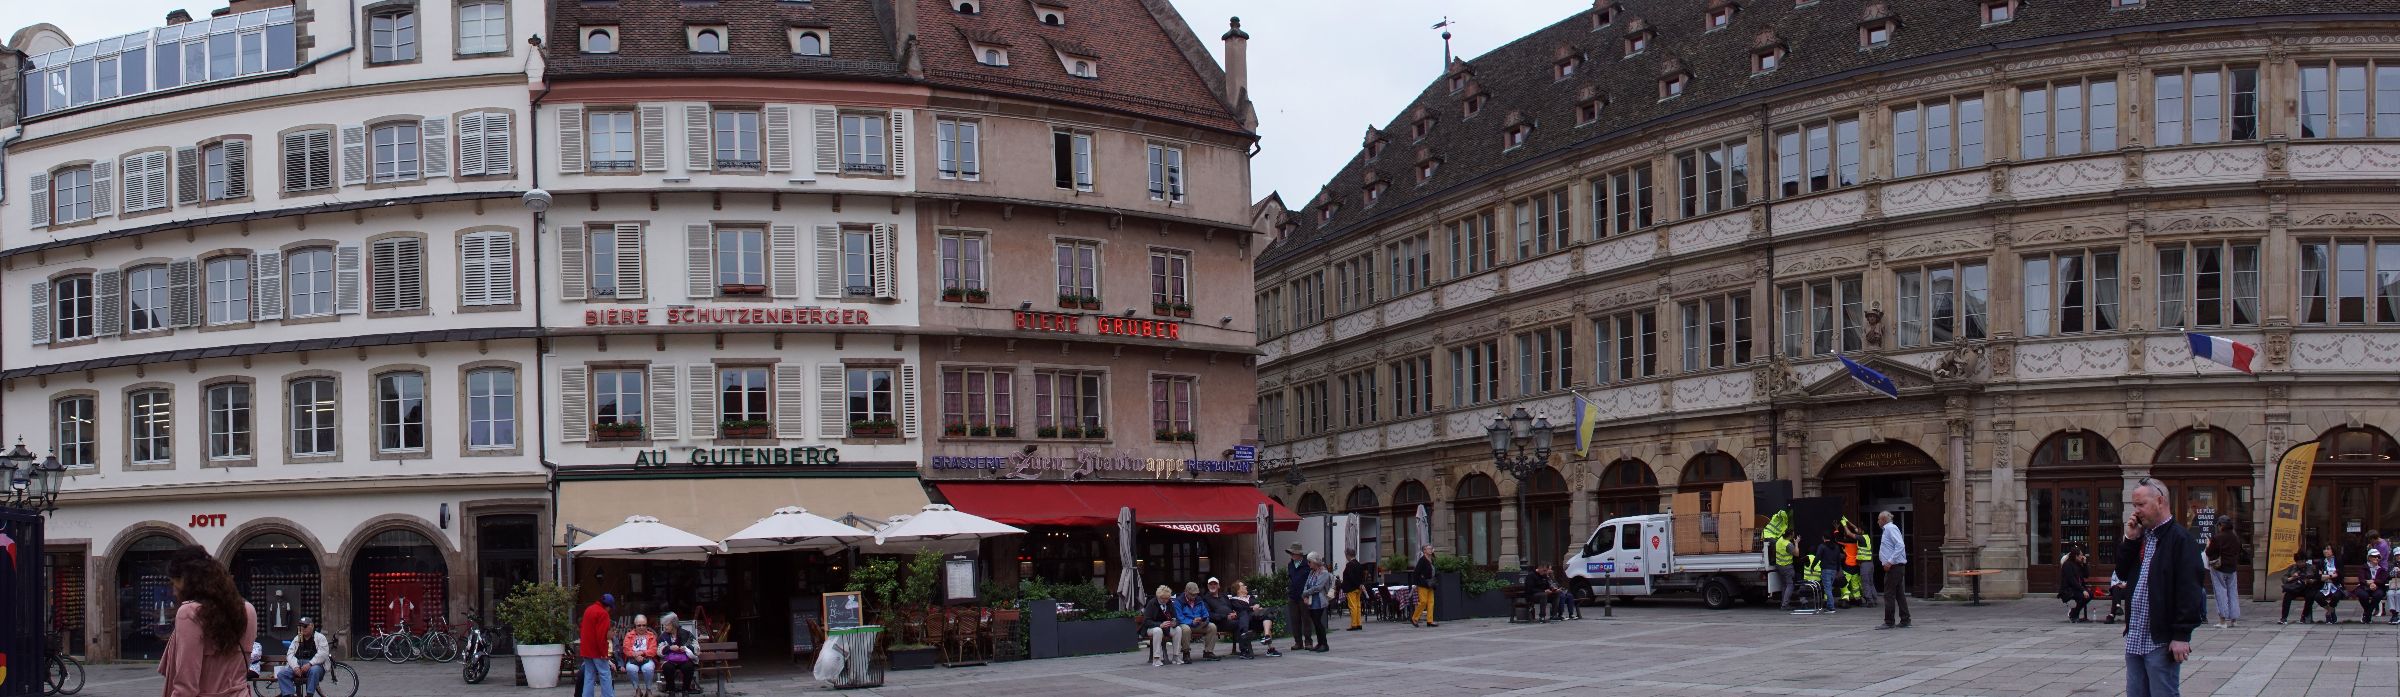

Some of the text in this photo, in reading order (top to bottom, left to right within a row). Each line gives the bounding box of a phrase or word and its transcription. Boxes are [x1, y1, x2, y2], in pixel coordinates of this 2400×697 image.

[667, 308, 869, 325] SCHUTZENBERGER
[1014, 311, 1180, 340] BIERE GRUBER
[634, 448, 840, 469] AU GUTENBERG
[932, 455, 1007, 470] BRASSERIE
[188, 513, 227, 528] JOTT
